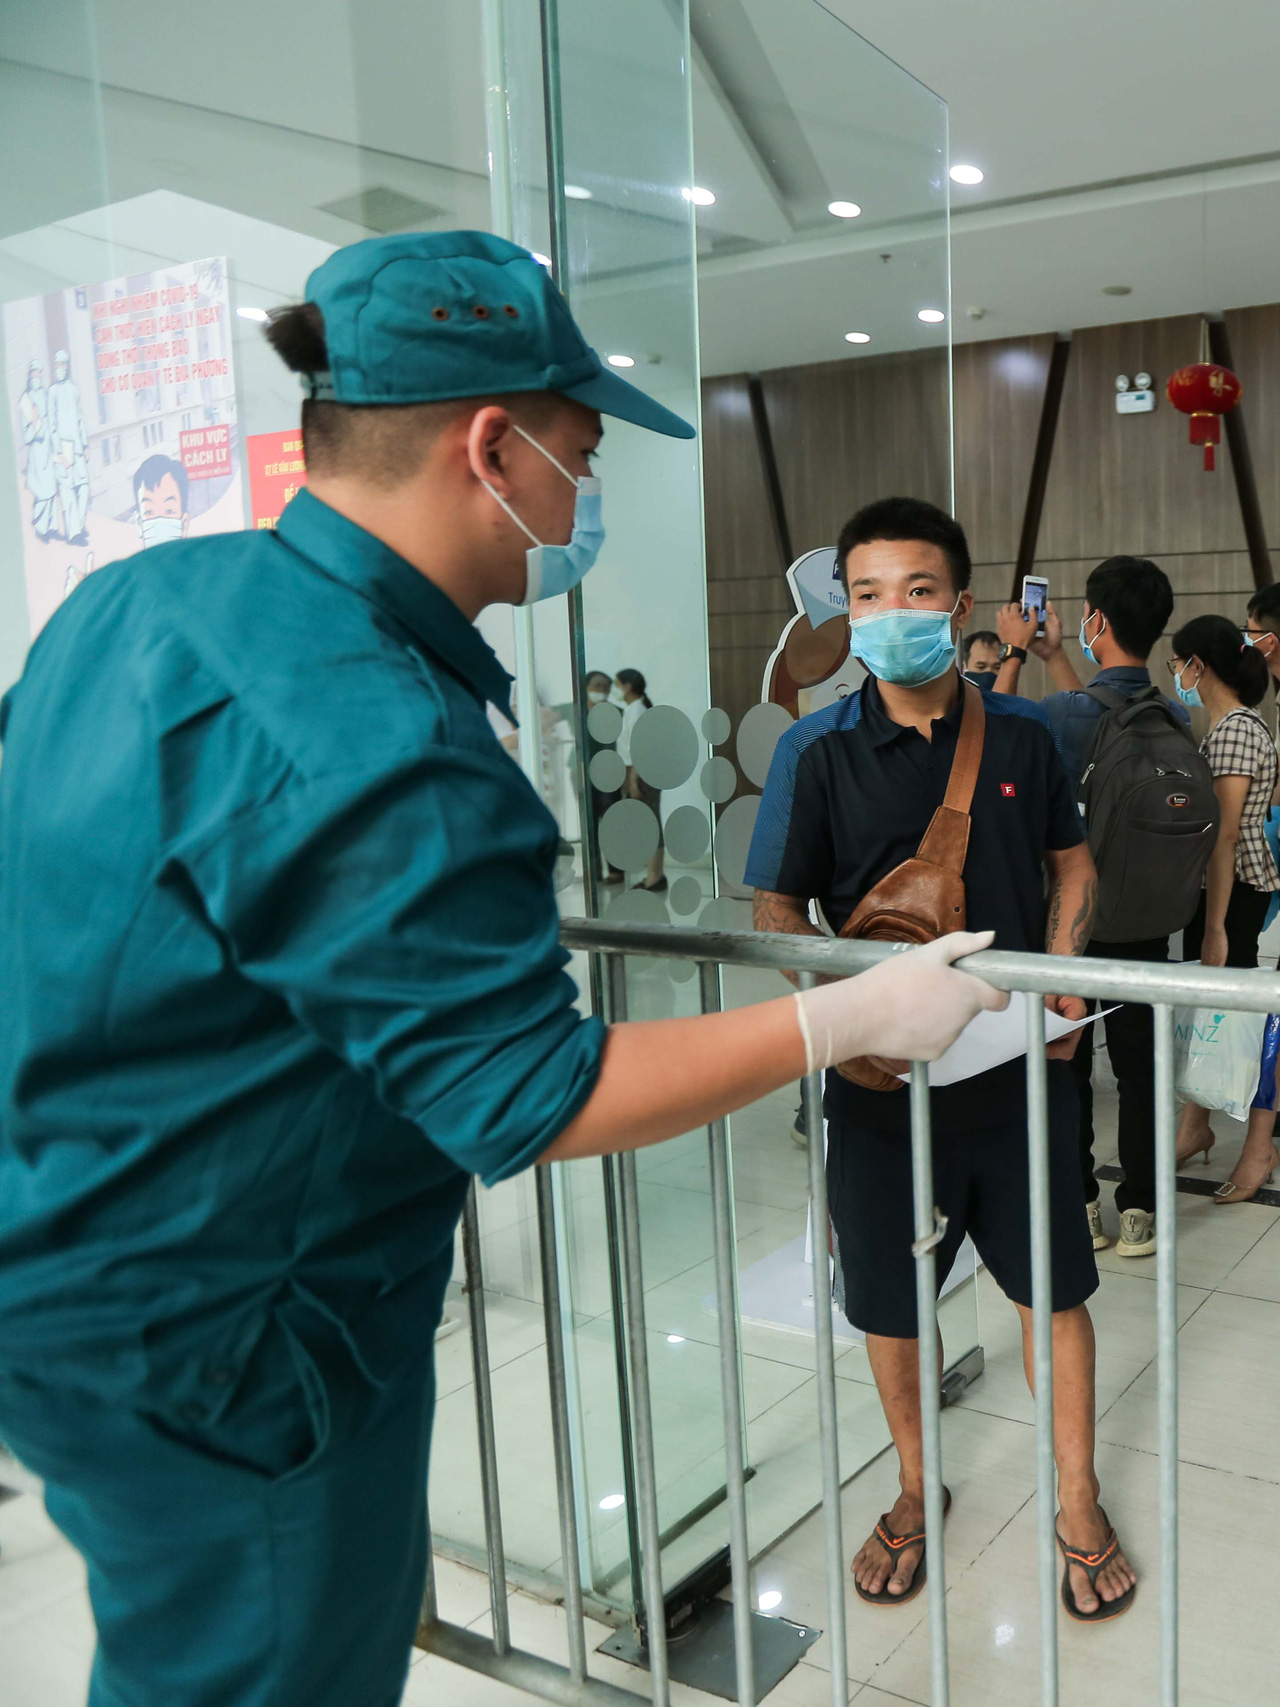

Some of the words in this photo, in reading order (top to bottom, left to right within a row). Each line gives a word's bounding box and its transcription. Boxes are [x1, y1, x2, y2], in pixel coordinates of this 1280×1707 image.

[160, 283, 199, 307] COVID-19
[182, 433, 204, 449] KHU
[206, 428, 228, 447] VỰC
[184, 449, 214, 467] CÁCH
[215, 448, 228, 463] LY
[828, 592, 848, 608] Truy
